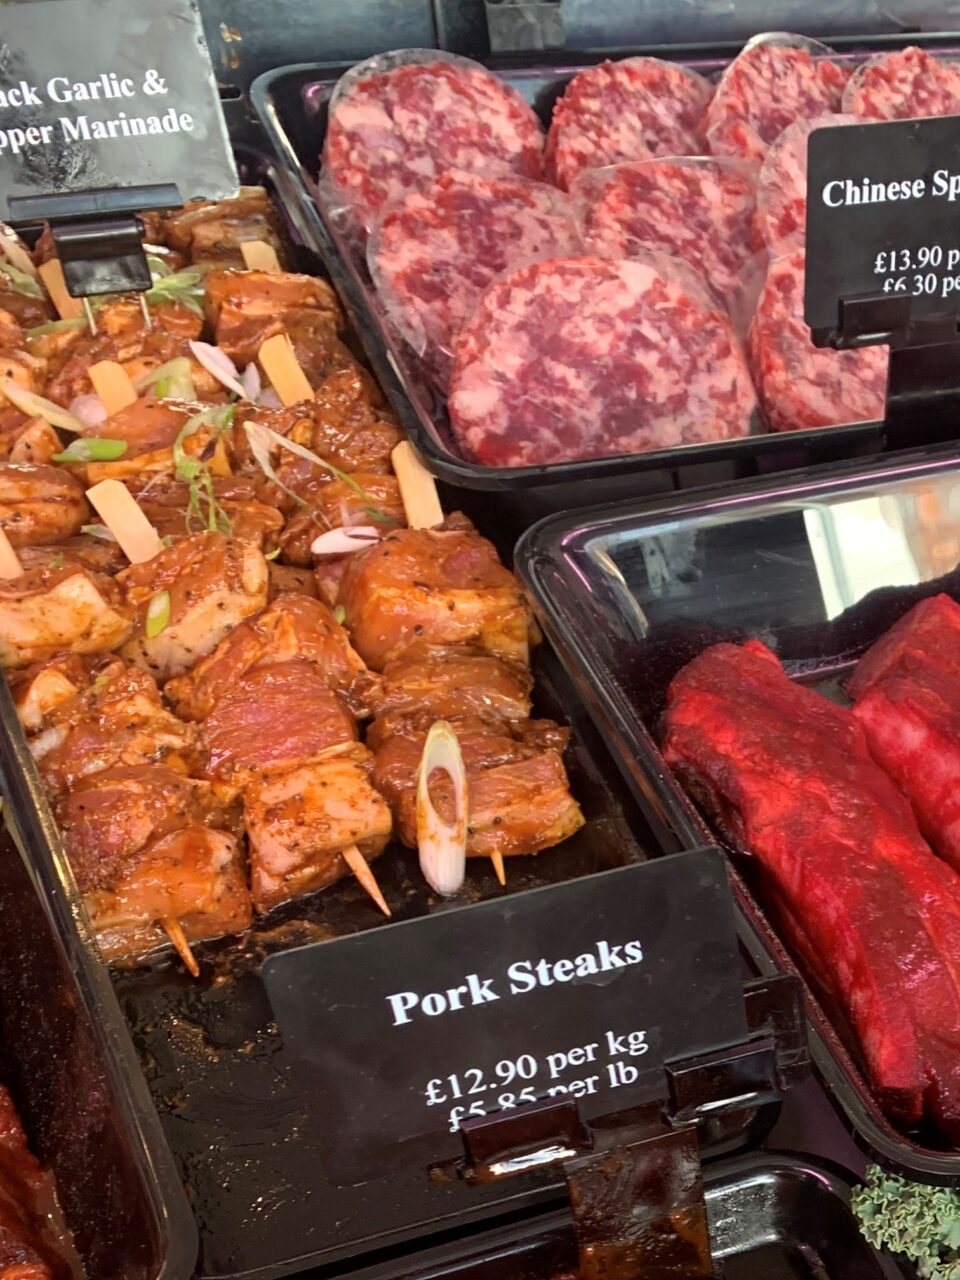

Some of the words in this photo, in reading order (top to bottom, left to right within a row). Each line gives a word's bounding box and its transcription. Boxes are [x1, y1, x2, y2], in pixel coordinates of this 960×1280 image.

[47, 72, 136, 102] Garlic
[142, 69, 168, 95] &
[59, 108, 194, 143] Marinade
[822, 178, 925, 207] Chinese
[874, 246, 942, 273] £13.90
[883, 273, 937, 295] £630
[385, 974, 500, 1026] Pork
[507, 940, 643, 994] Steaks
[425, 1054, 537, 1106] £12.90
[546, 1042, 598, 1077] per
[606, 1030, 649, 1056] kg
[448, 1087, 537, 1132] £585
[606, 1061, 638, 1088] lb
